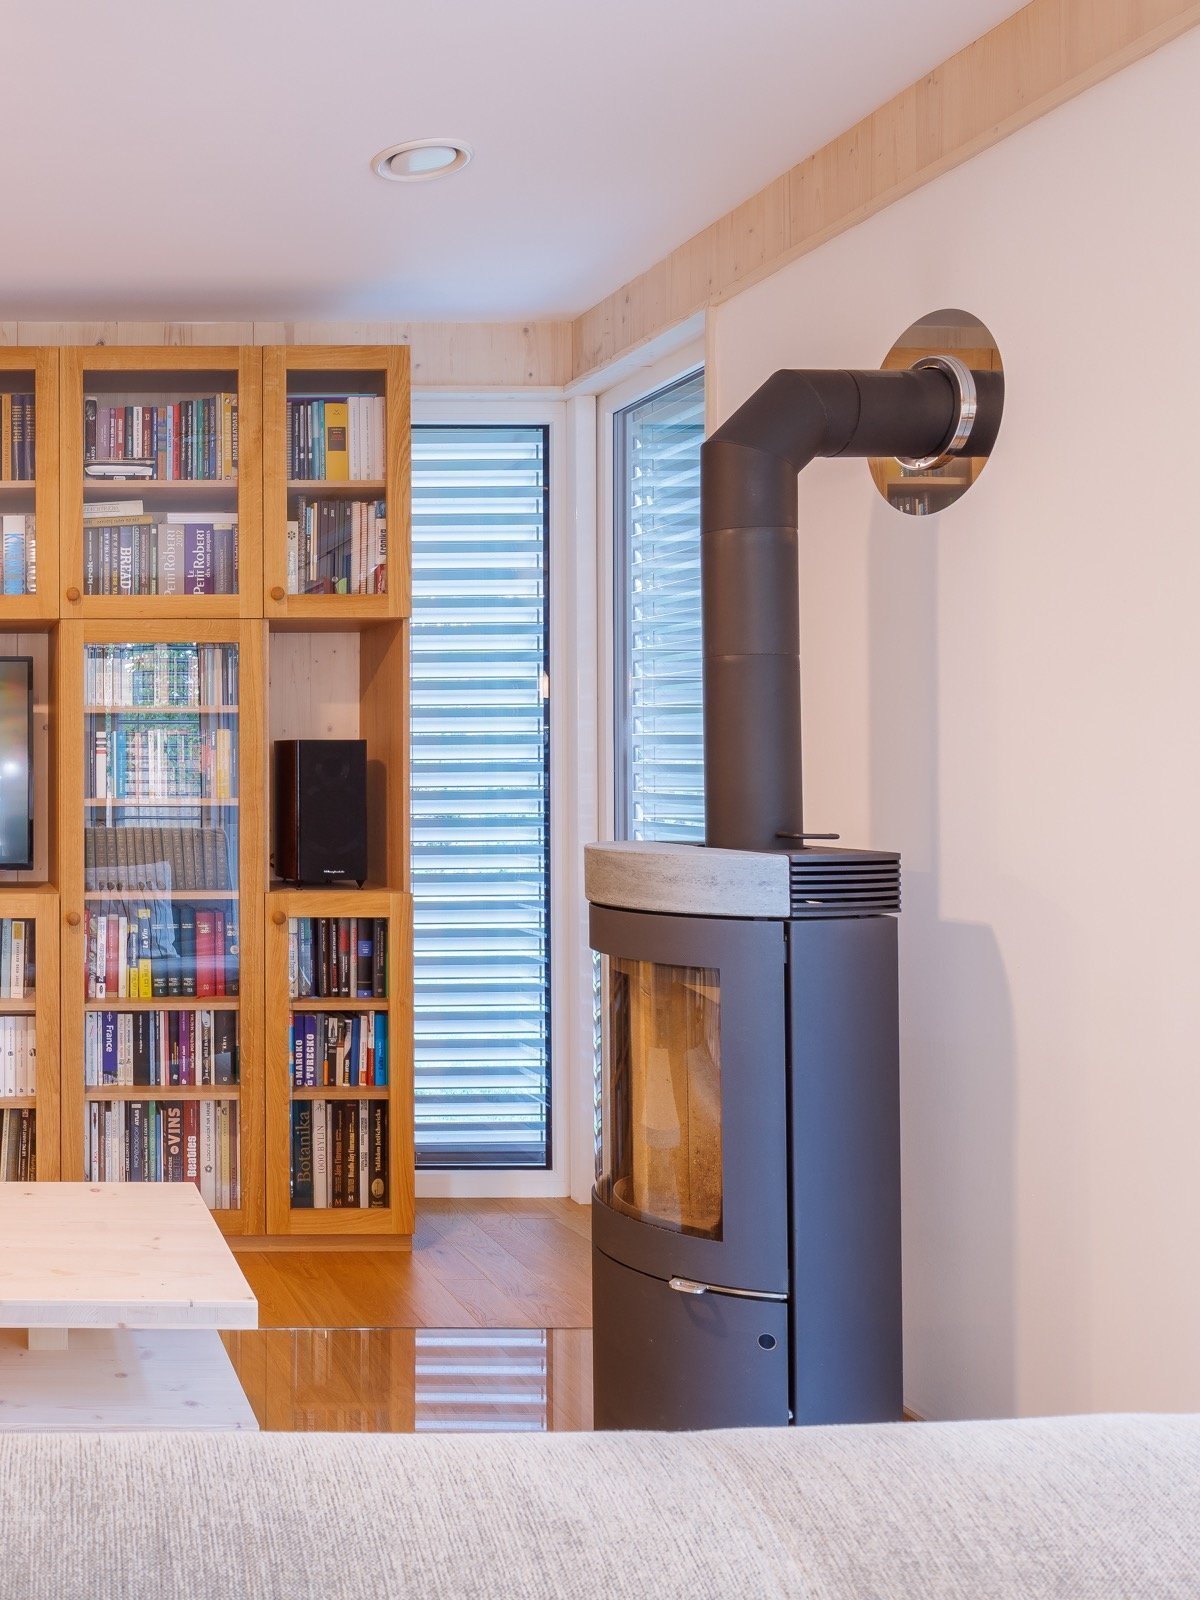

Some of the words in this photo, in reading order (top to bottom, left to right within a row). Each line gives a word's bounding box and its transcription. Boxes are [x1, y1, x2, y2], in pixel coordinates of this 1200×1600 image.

[378, 528, 387, 556] Kronika
[86, 561, 94, 584] krok
[119, 546, 132, 590] BREAD
[142, 939, 149, 949] Le
[105, 1024, 115, 1053] France
[306, 1034, 315, 1079] TURECKO
[167, 1108, 181, 1145] VINS
[317, 1125, 325, 1152] BYLIN
[187, 1135, 197, 1178] Beatles
[295, 1111, 311, 1183] Botanika
[317, 1154, 325, 1175] 1000
